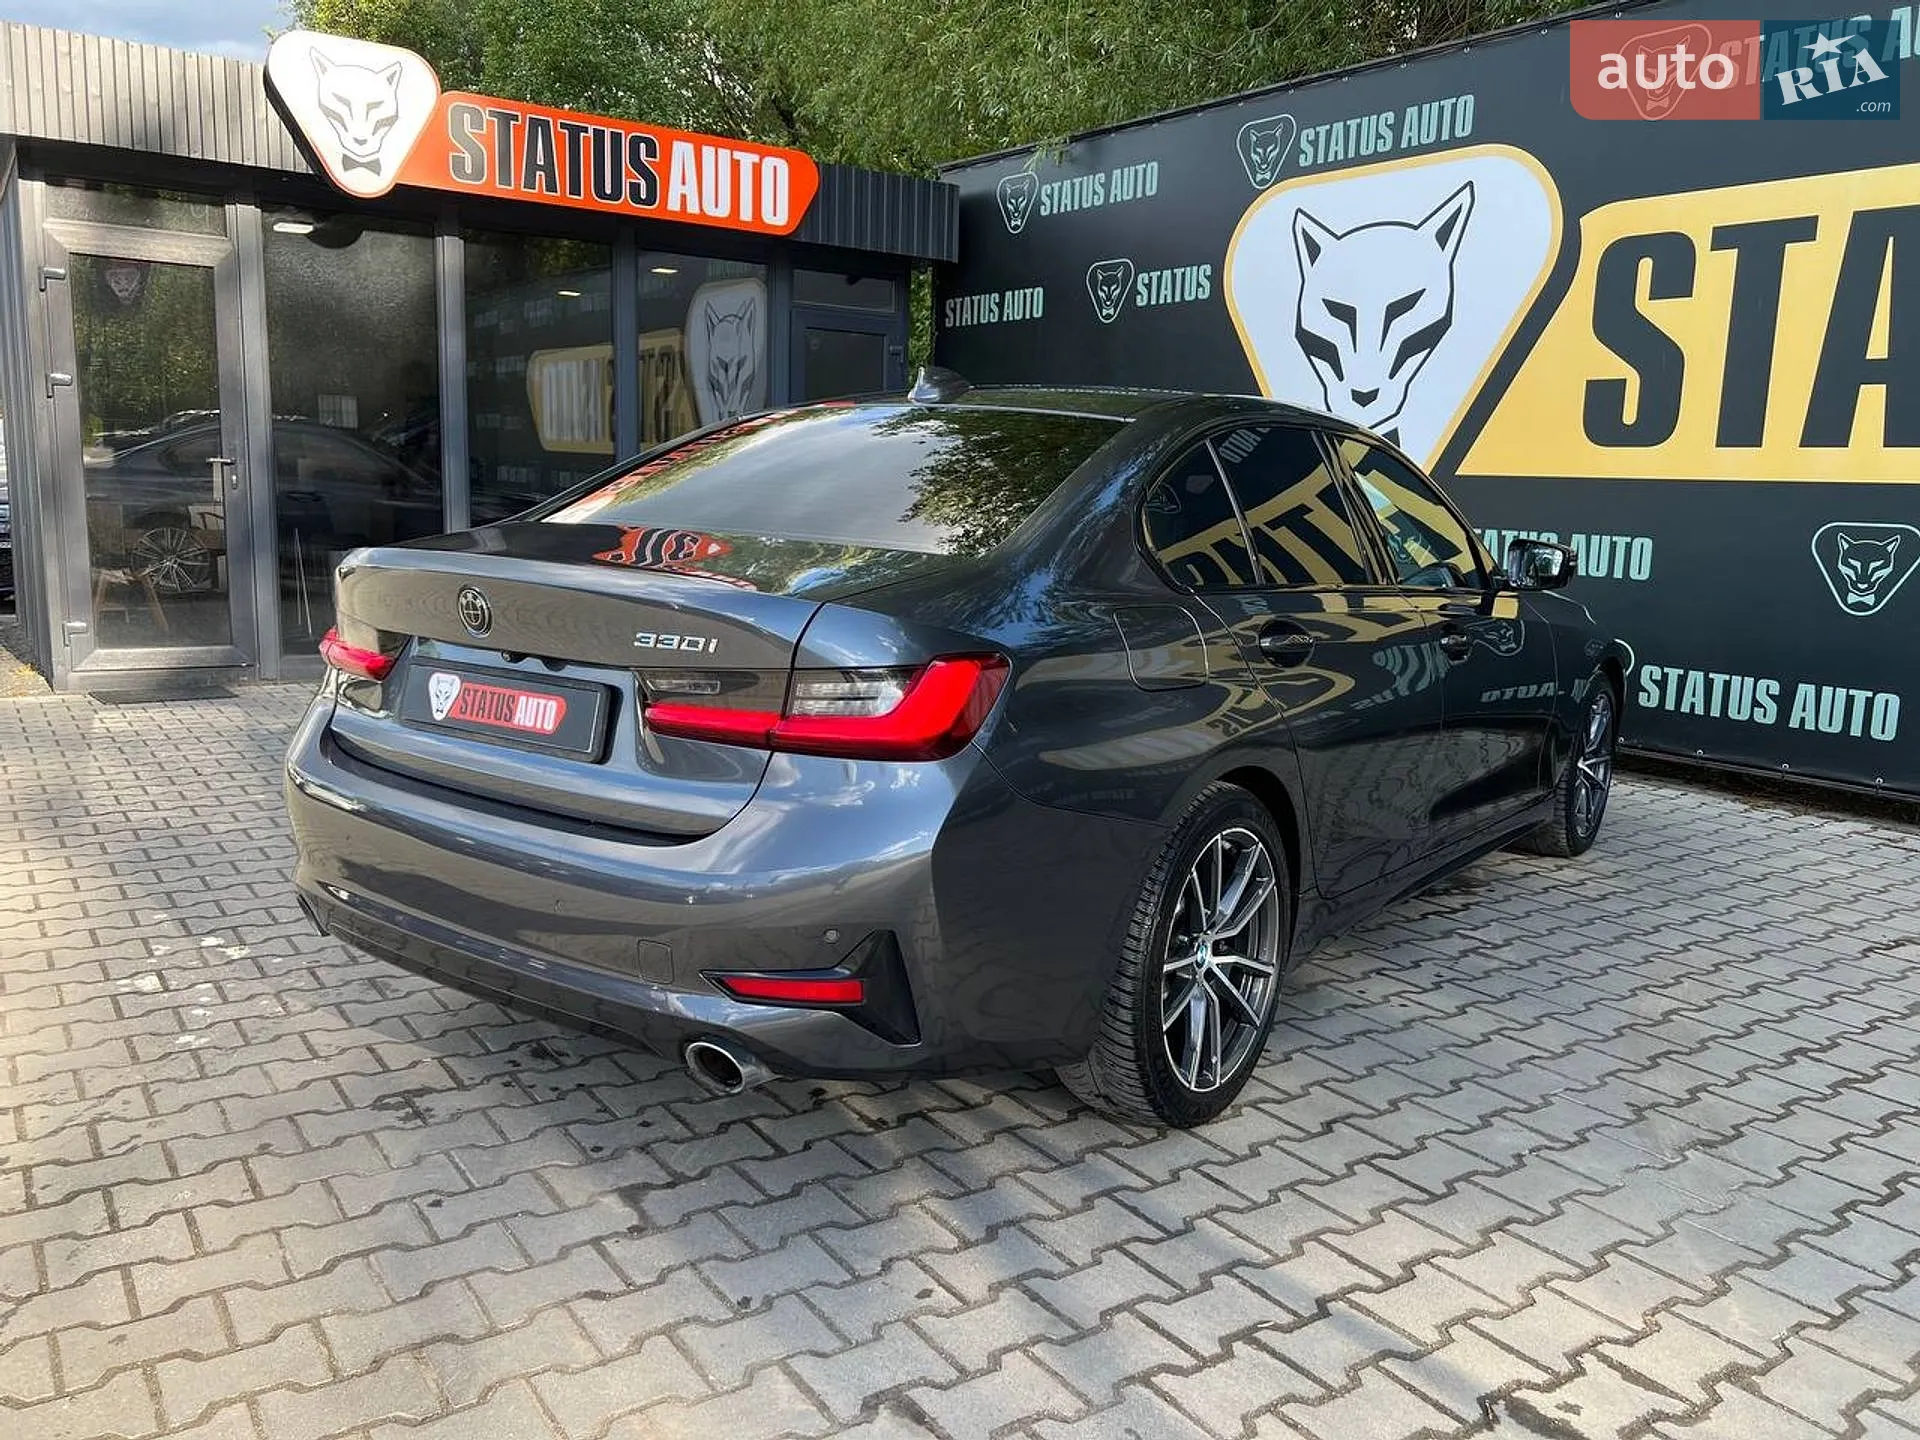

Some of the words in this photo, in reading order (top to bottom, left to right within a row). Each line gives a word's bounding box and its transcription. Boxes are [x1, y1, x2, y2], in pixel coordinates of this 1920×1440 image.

[1299, 111, 1395, 167] STATUS
[1400, 94, 1475, 149] AUTO
[448, 102, 660, 209] STATUS
[666, 140, 789, 227] AUTO
[1040, 172, 1105, 216] STATUS
[1110, 161, 1159, 204] AUTO
[945, 292, 999, 328] STATUS
[1002, 287, 1044, 322] AUTO
[1136, 264, 1212, 307] STATUS
[1583, 204, 1920, 448] STA
[1570, 534, 1653, 580] AUTO
[461, 687, 515, 722] STATUS
[513, 695, 557, 730] AUTO
[1638, 665, 1781, 724] STATUS
[1788, 683, 1901, 741] AUTO
